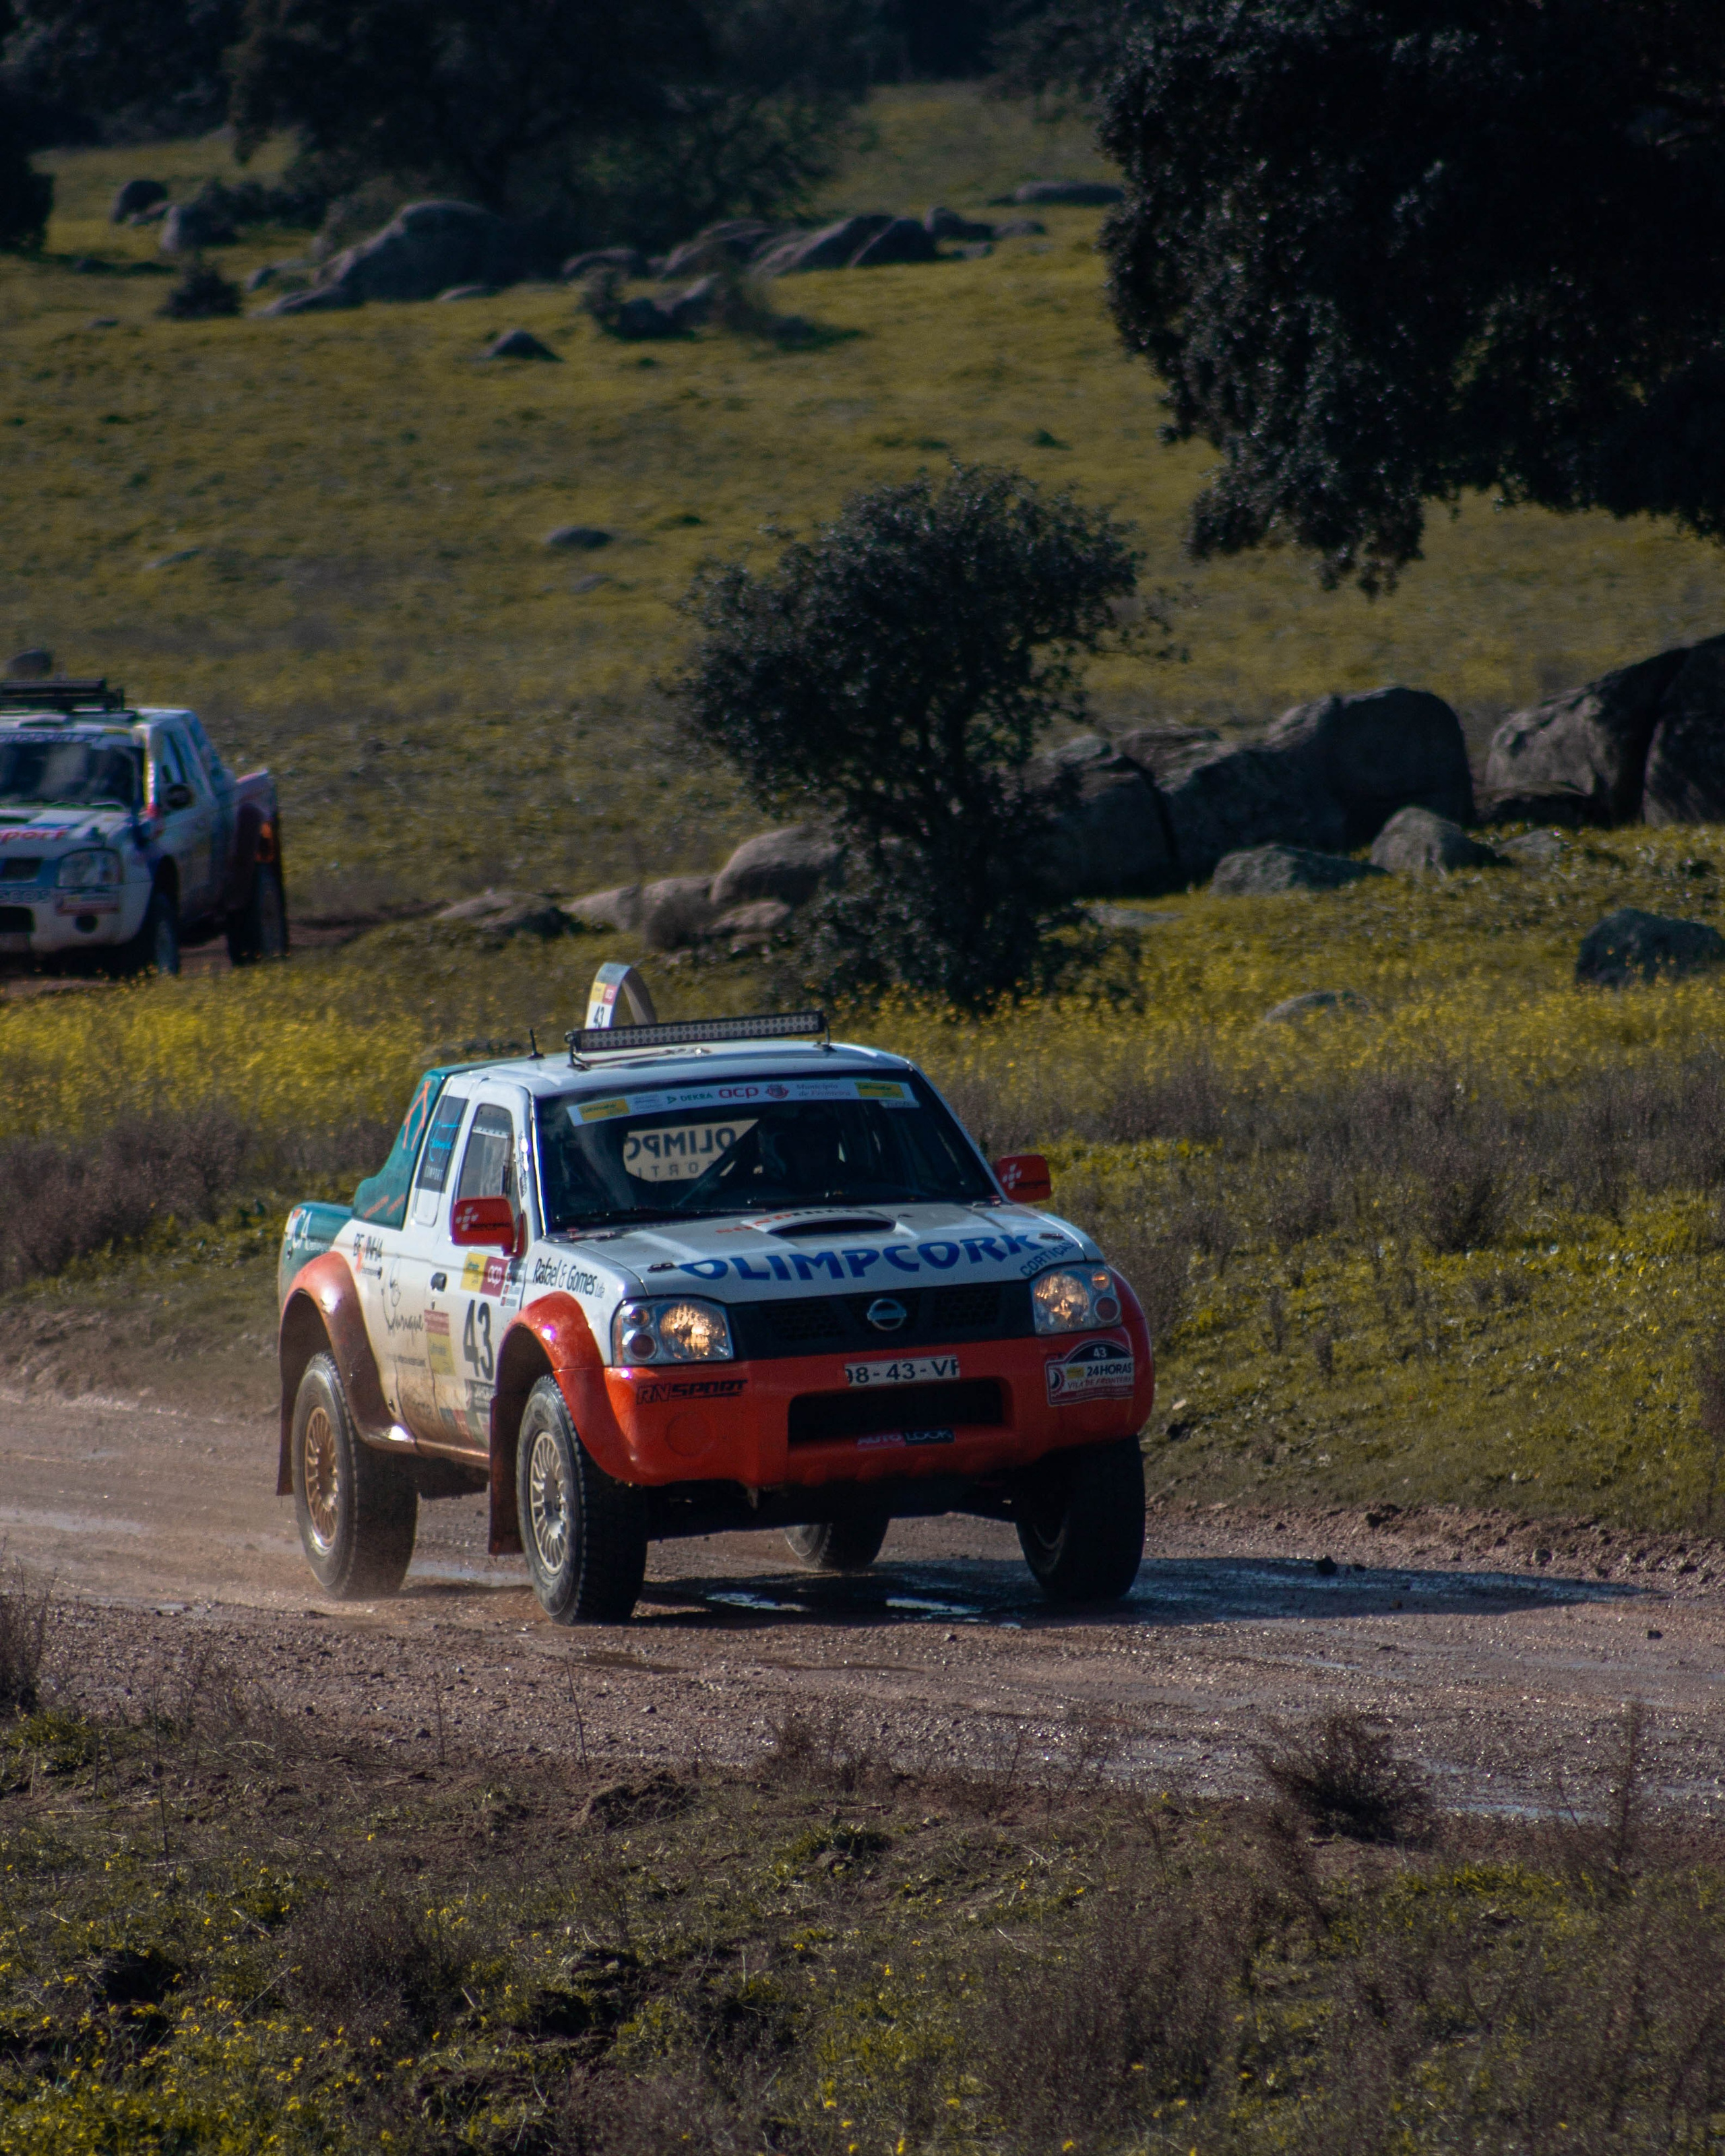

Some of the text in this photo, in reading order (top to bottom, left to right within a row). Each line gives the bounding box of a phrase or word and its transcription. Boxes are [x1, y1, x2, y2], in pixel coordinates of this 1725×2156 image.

[680, 1092, 714, 1102] DEKRA
[718, 1085, 759, 1099] acp
[678, 1234, 1043, 1281] OLIMPCORK
[532, 1257, 562, 1287] Rafael
[567, 1265, 597, 1295] Gomes
[463, 1300, 494, 1381] 43
[1093, 1348, 1107, 1358] 43
[906, 1429, 952, 1441] LOOK
